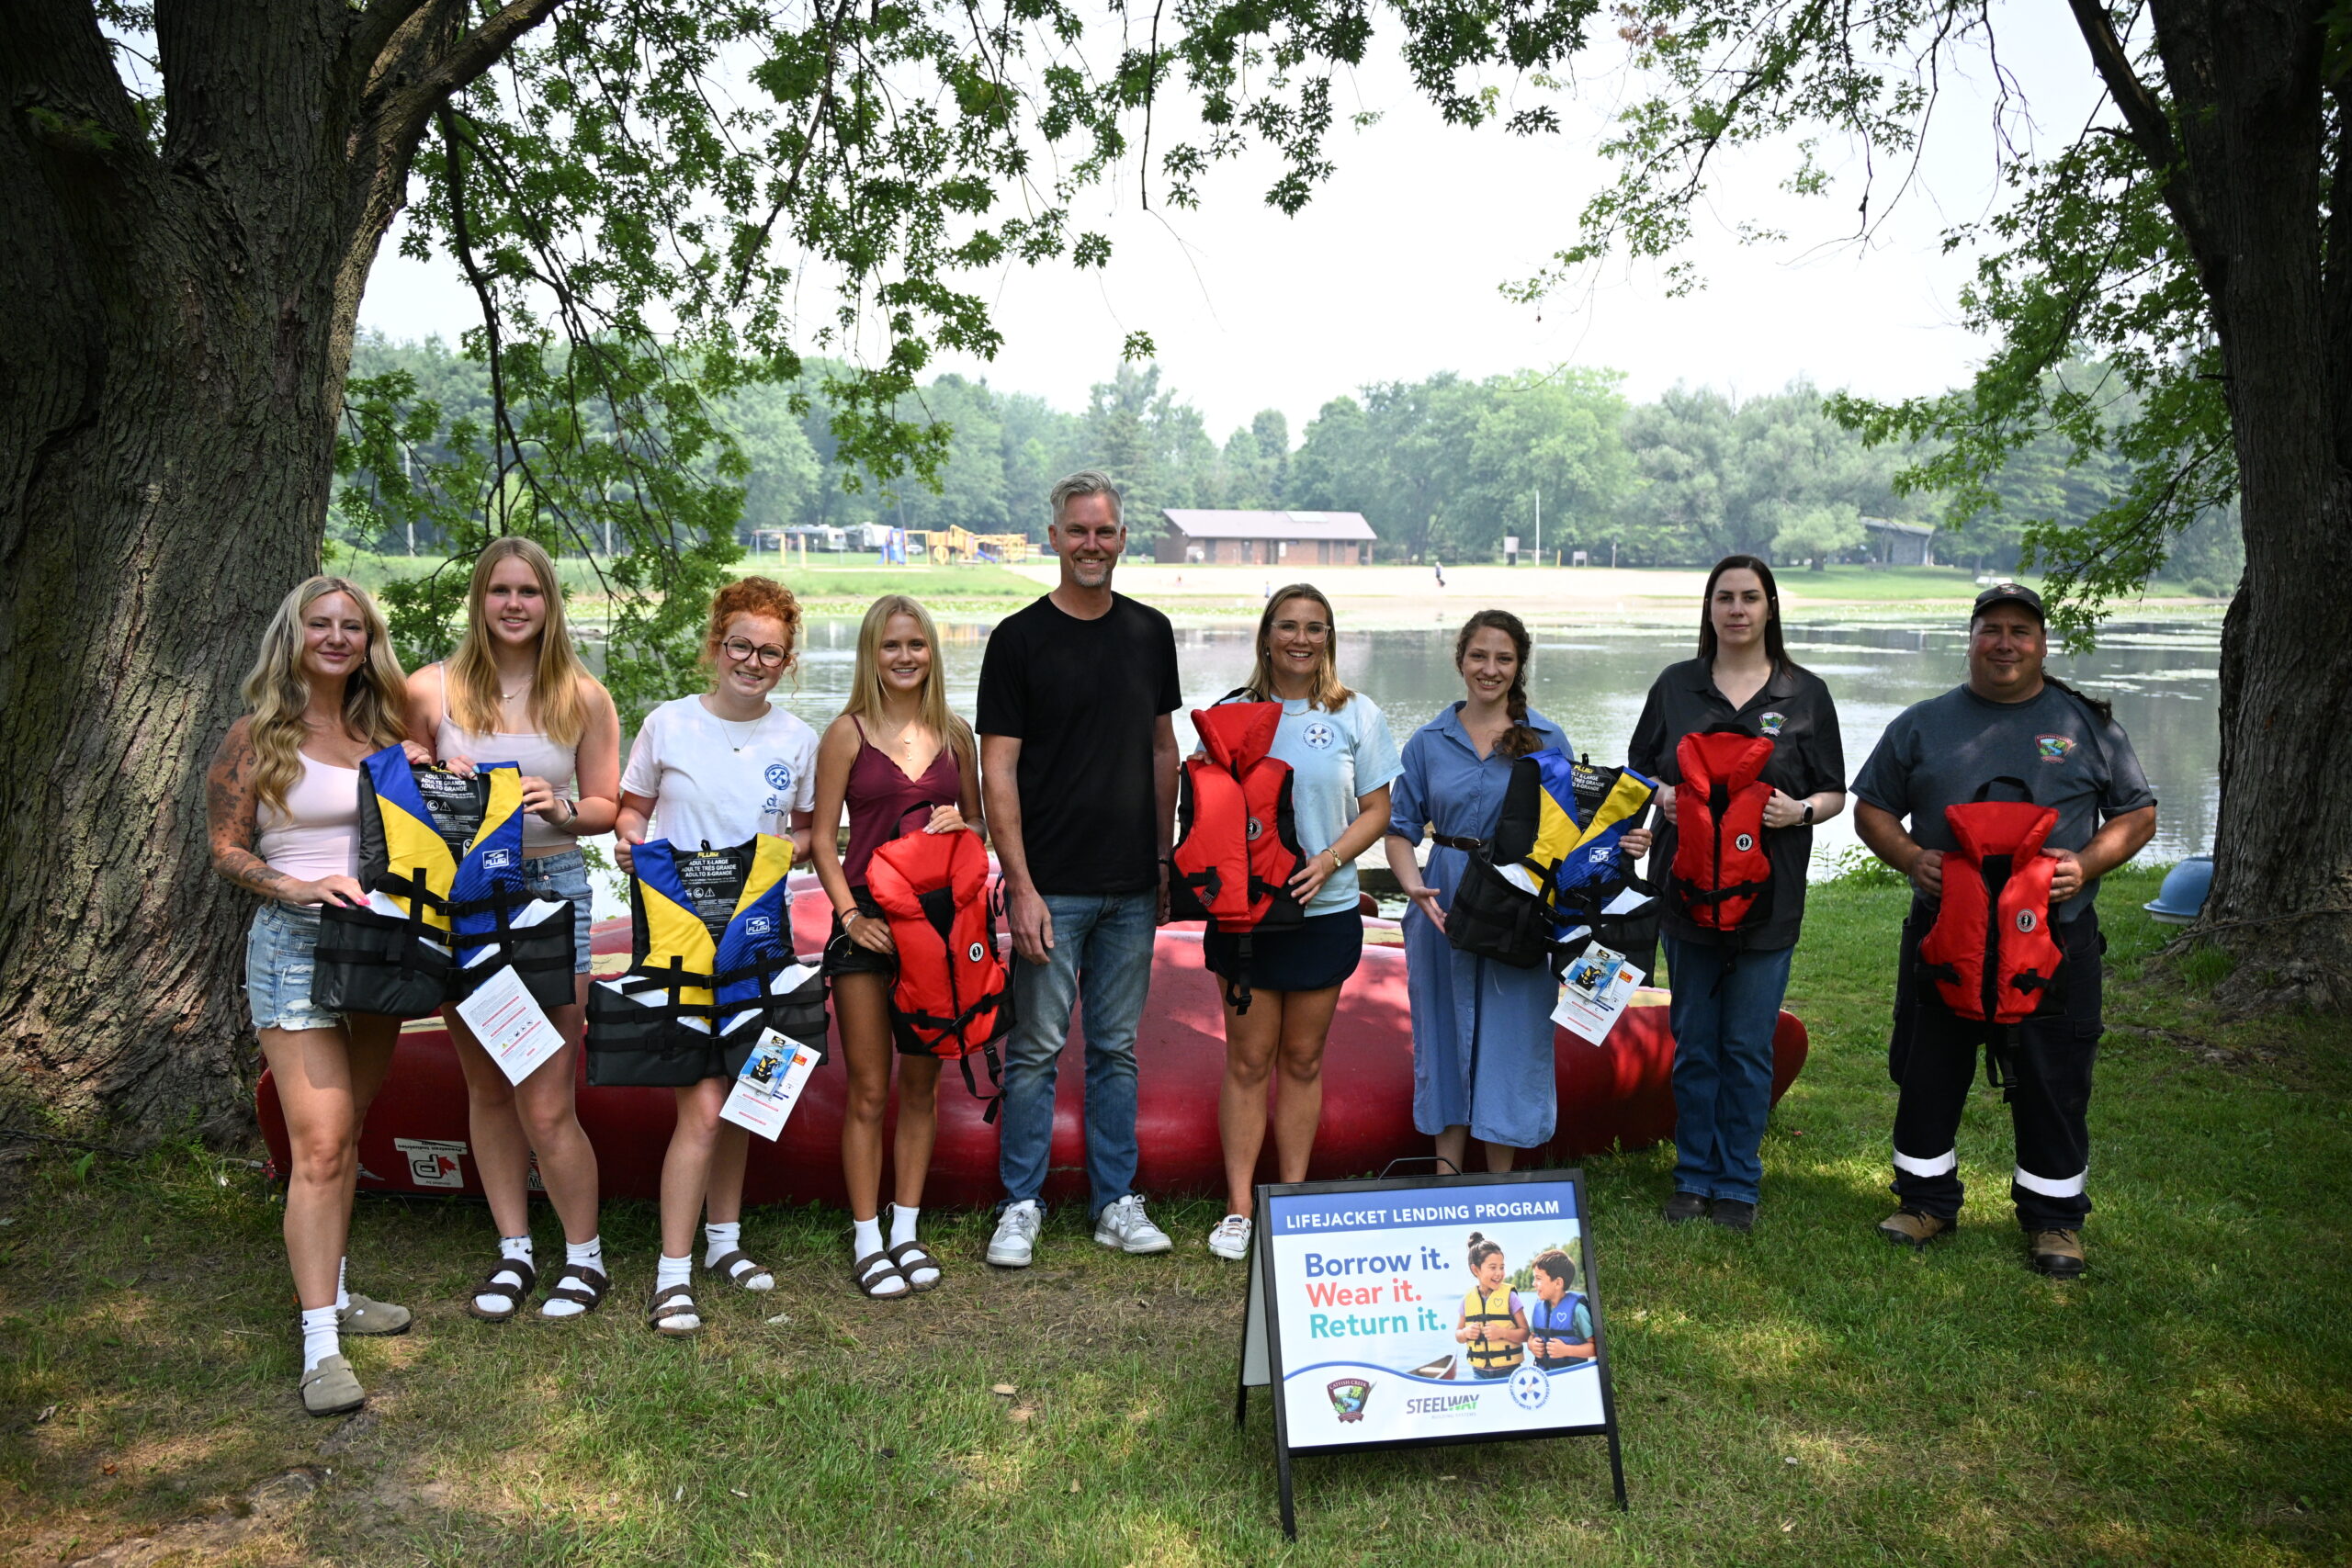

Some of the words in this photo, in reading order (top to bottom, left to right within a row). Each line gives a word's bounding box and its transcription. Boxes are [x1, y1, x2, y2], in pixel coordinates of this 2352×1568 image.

[1286, 1210, 1387, 1229] LIFEJACKET
[1393, 1205, 1470, 1223] LENDING
[1475, 1200, 1560, 1218] PROGRAM
[1305, 1253, 1412, 1278] Borrow
[1420, 1246, 1450, 1270] it.
[1305, 1281, 1384, 1308] Wear
[1392, 1278, 1422, 1303] it.
[1310, 1313, 1408, 1339] Return
[1417, 1306, 1447, 1332] it.
[1329, 1380, 1351, 1390] CATFISH
[1406, 1393, 1480, 1415] STEELWAY
